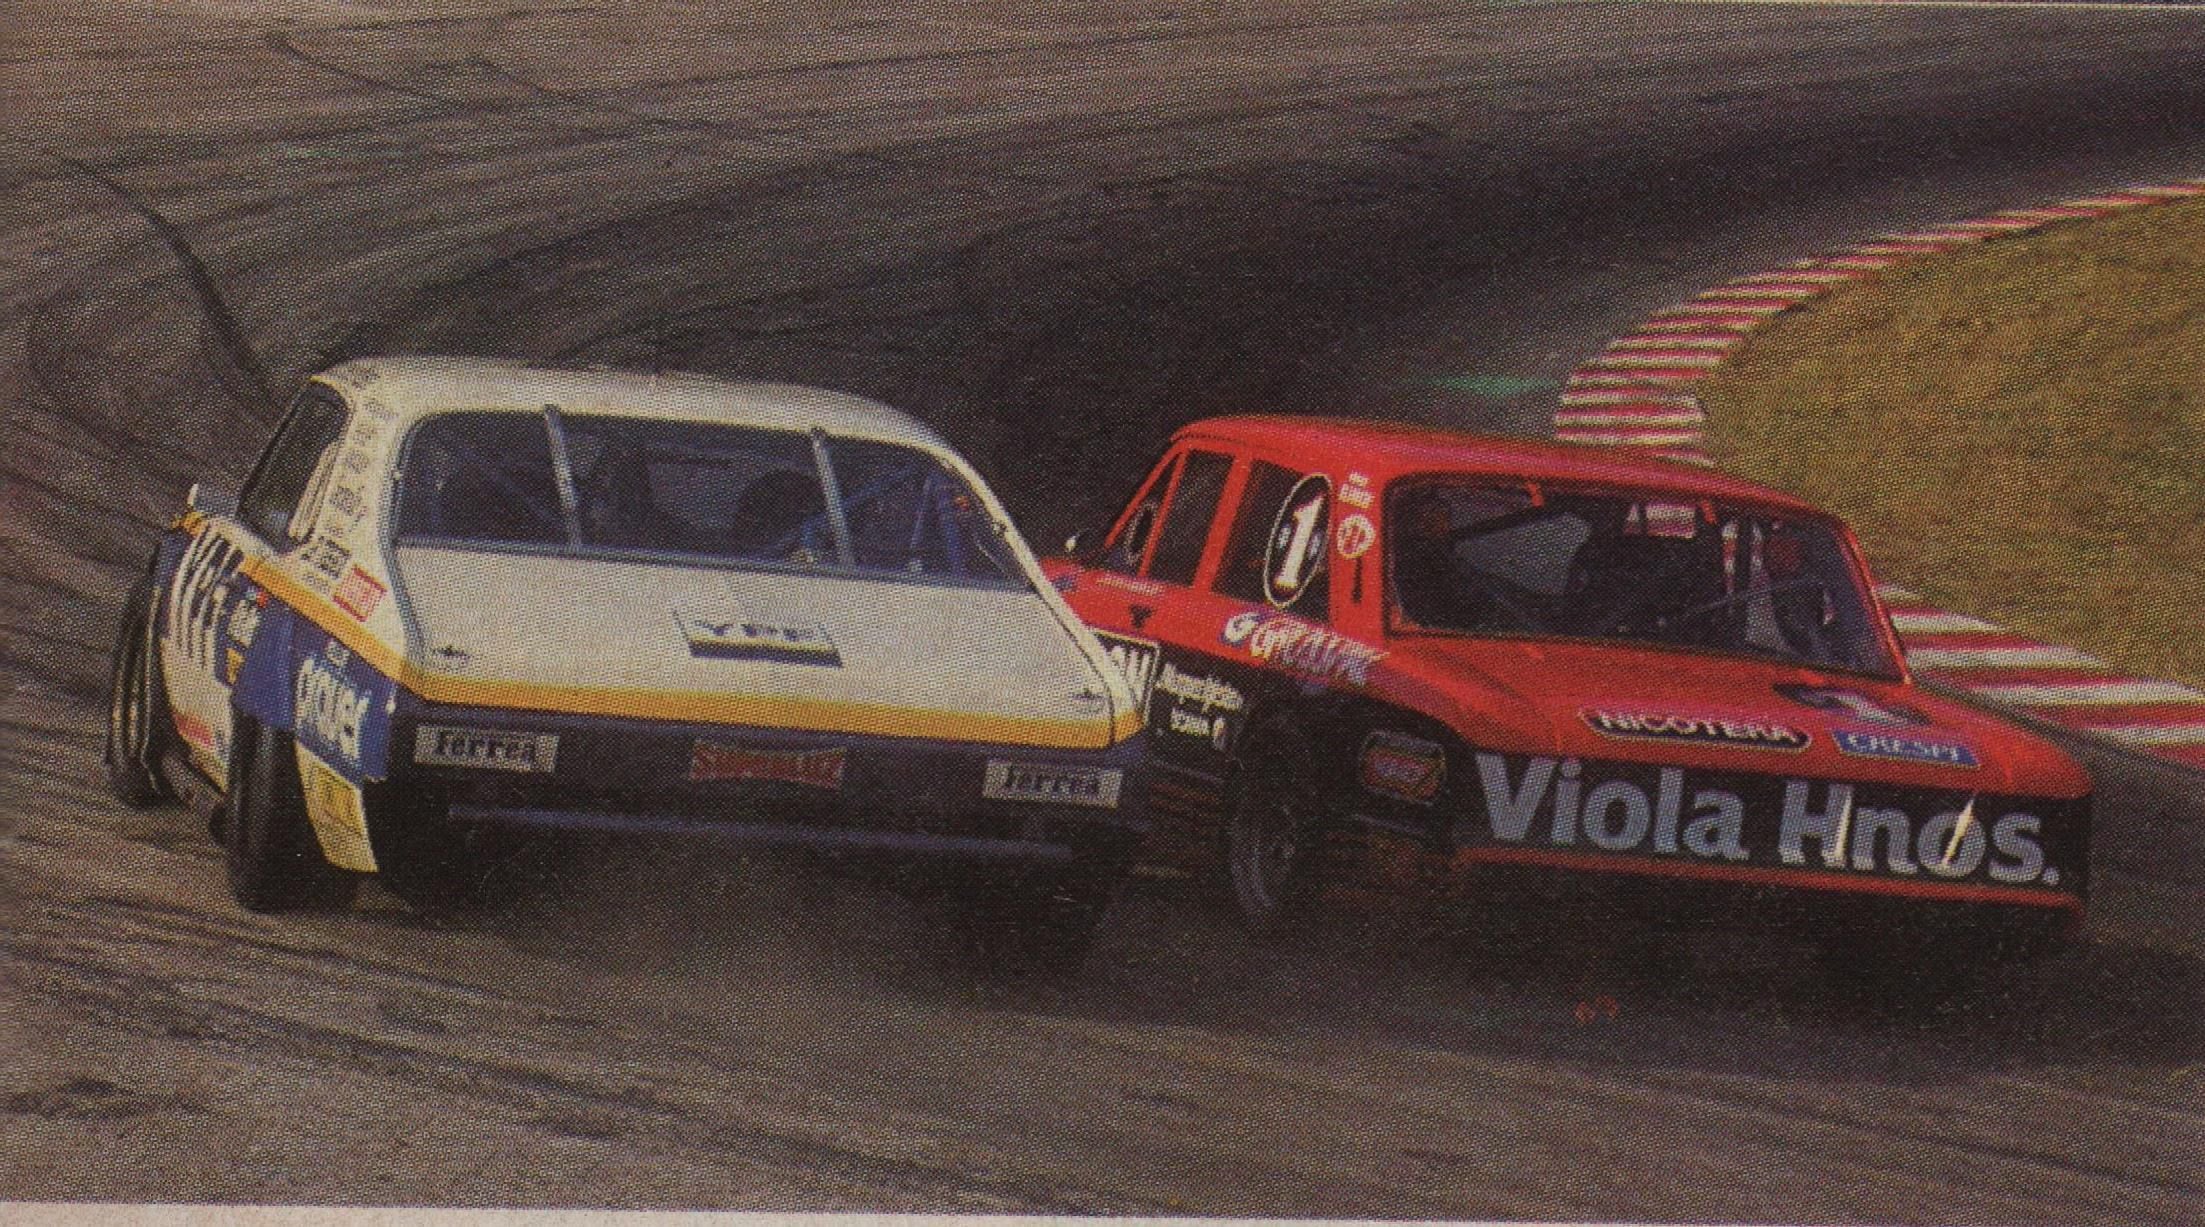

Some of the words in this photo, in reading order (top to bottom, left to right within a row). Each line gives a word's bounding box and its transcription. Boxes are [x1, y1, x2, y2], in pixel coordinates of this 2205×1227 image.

[1273, 494, 1325, 589] 1
[694, 619, 816, 643] YPF
[1598, 709, 1800, 744] NICOTERA
[1845, 730, 1962, 763] CRESPI
[1475, 752, 1750, 863] Viola
[1778, 780, 2061, 886] Hnos.
